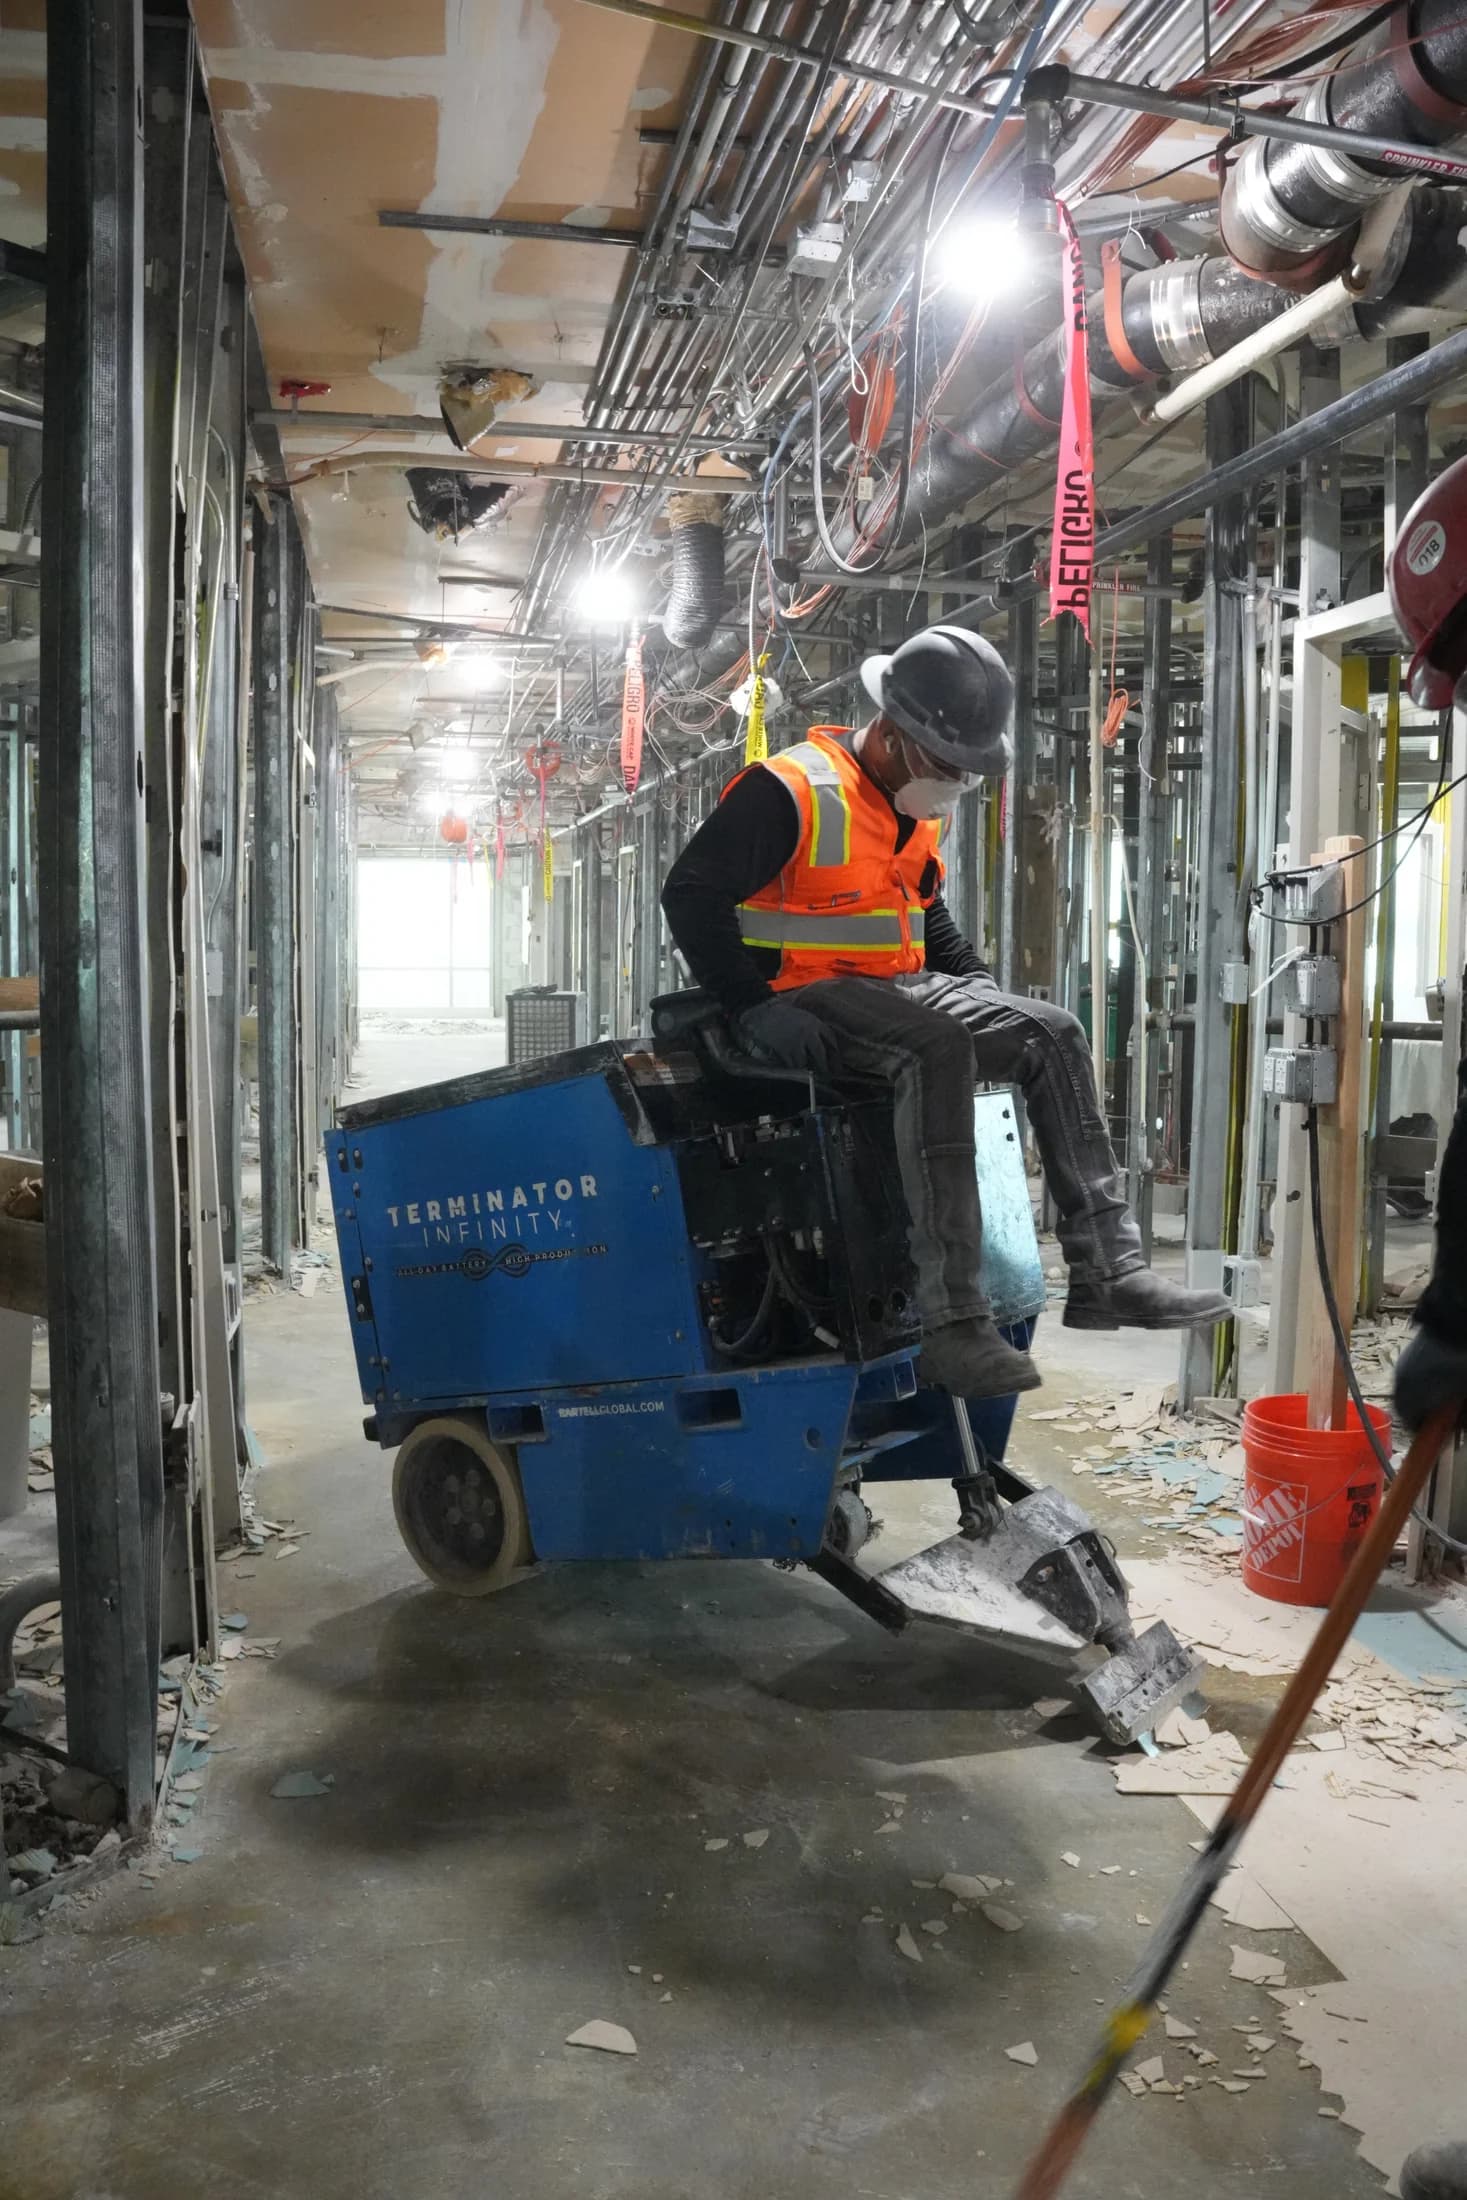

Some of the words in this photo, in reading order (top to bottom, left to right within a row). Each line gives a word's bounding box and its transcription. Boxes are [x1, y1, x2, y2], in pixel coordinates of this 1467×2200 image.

[387, 1175, 598, 1227] TERMINATOR
[424, 1209, 561, 1248] INFINITY
[505, 1255, 530, 1265] HIGH
[535, 1245, 607, 1261] PRODUION
[1251, 1521, 1303, 1570] DEPOT
